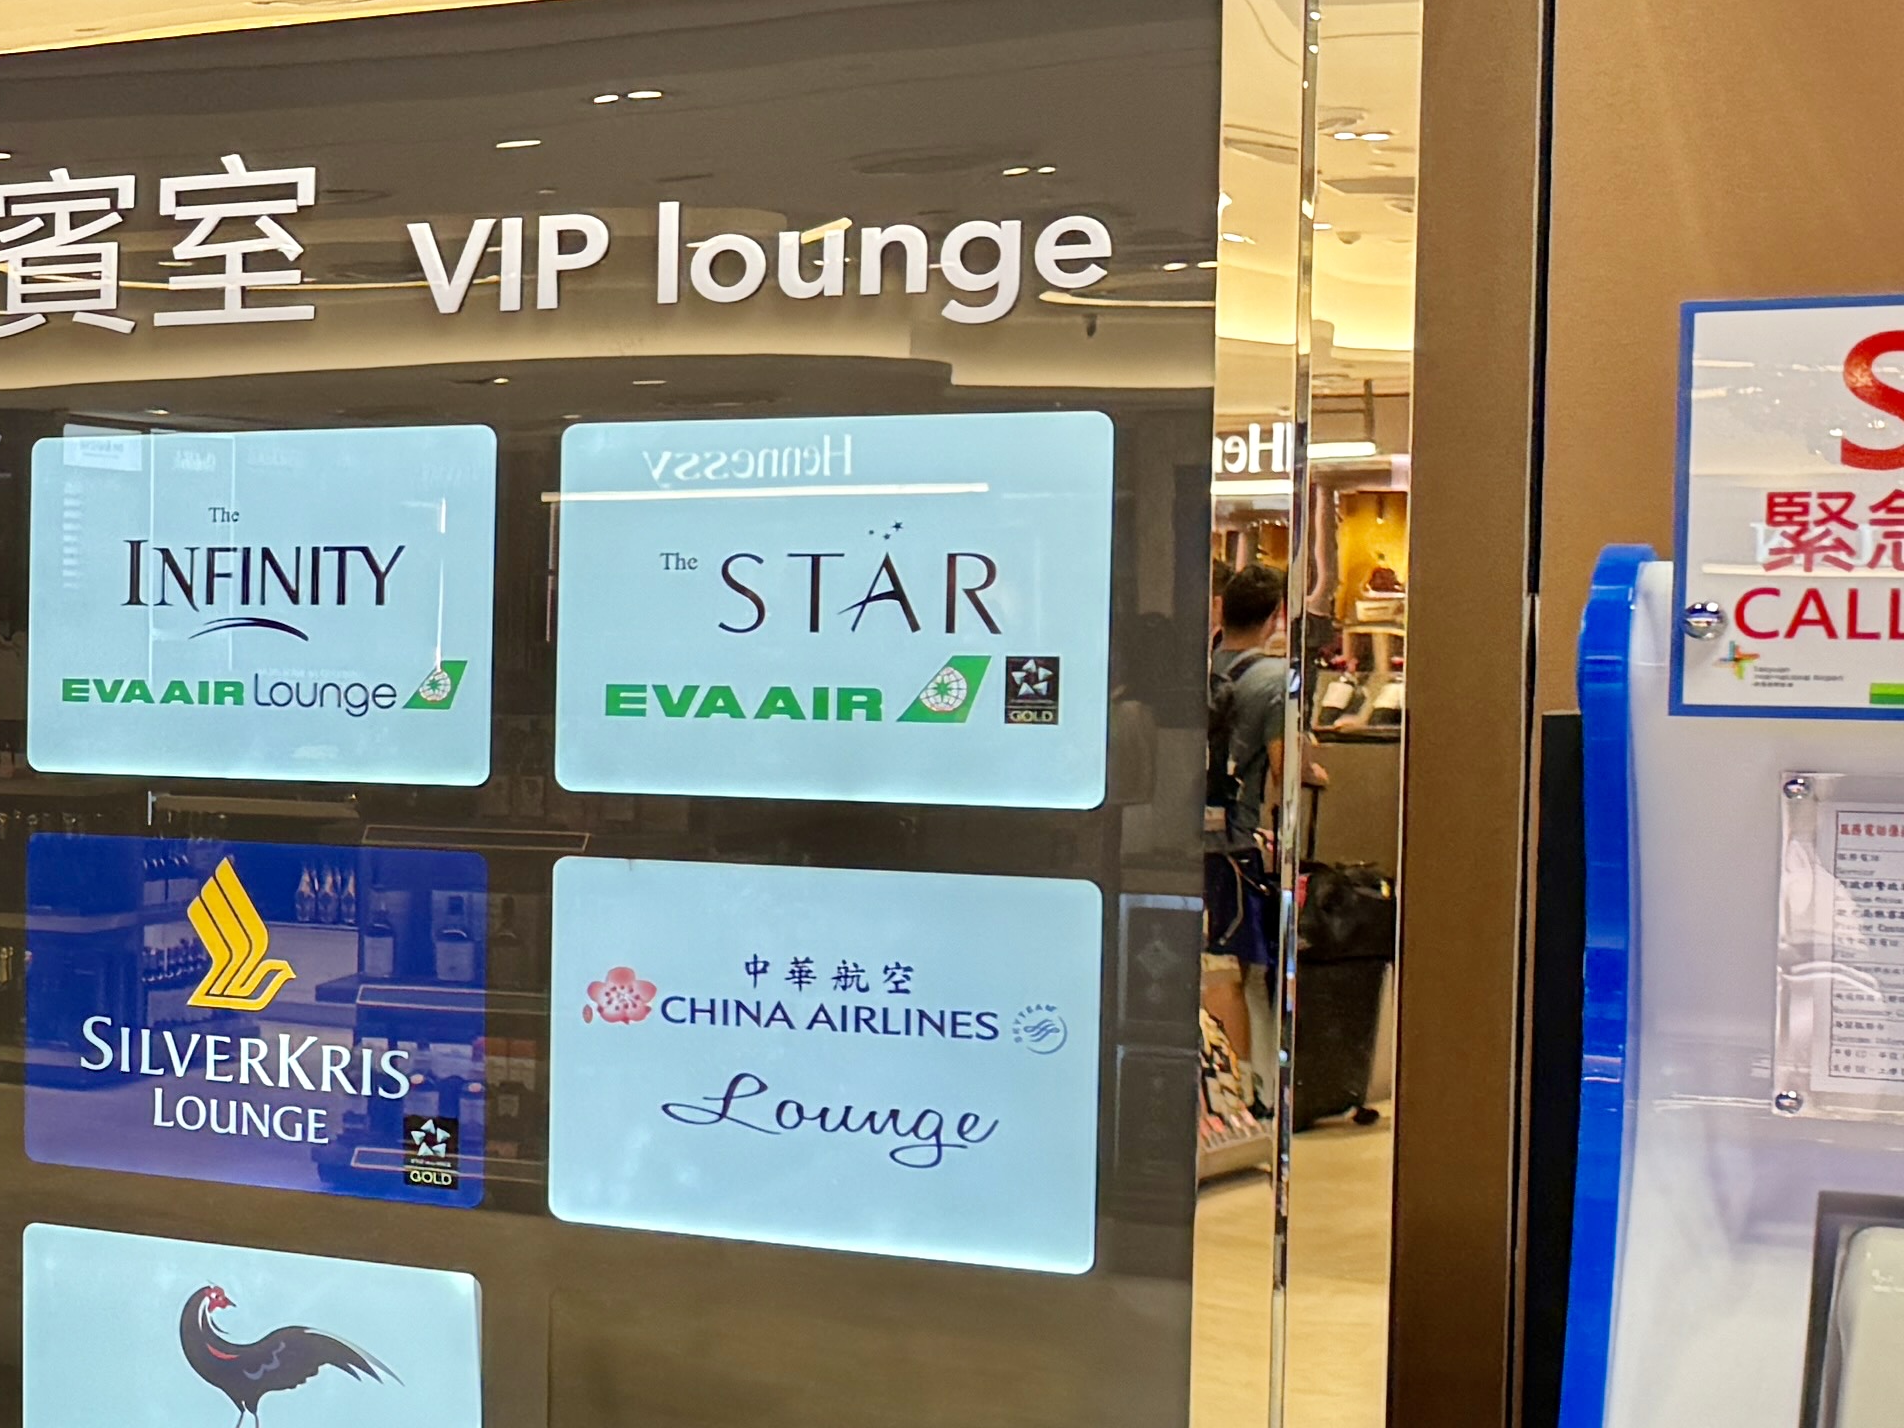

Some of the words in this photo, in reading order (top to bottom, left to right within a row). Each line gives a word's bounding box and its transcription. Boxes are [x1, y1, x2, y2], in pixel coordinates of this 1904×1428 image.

[406, 213, 610, 315] VIP
[657, 201, 1113, 324] lounge
[1840, 329, 1904, 471] S
[208, 506, 241, 523] The
[122, 537, 406, 609] INFINITY
[659, 552, 699, 571] The
[718, 551, 1003, 634] STAR
[1734, 588, 1904, 640] CALL
[253, 671, 398, 718] Lounge
[1010, 709, 1054, 724] GOLD
[743, 953, 914, 994] 中華航空
[660, 995, 797, 1030] CHINA
[806, 1004, 1000, 1041] AIRLINES
[151, 1086, 329, 1145] LOUNGE
[662, 1072, 1000, 1169] Lounge
[409, 1170, 452, 1185] GOLD
